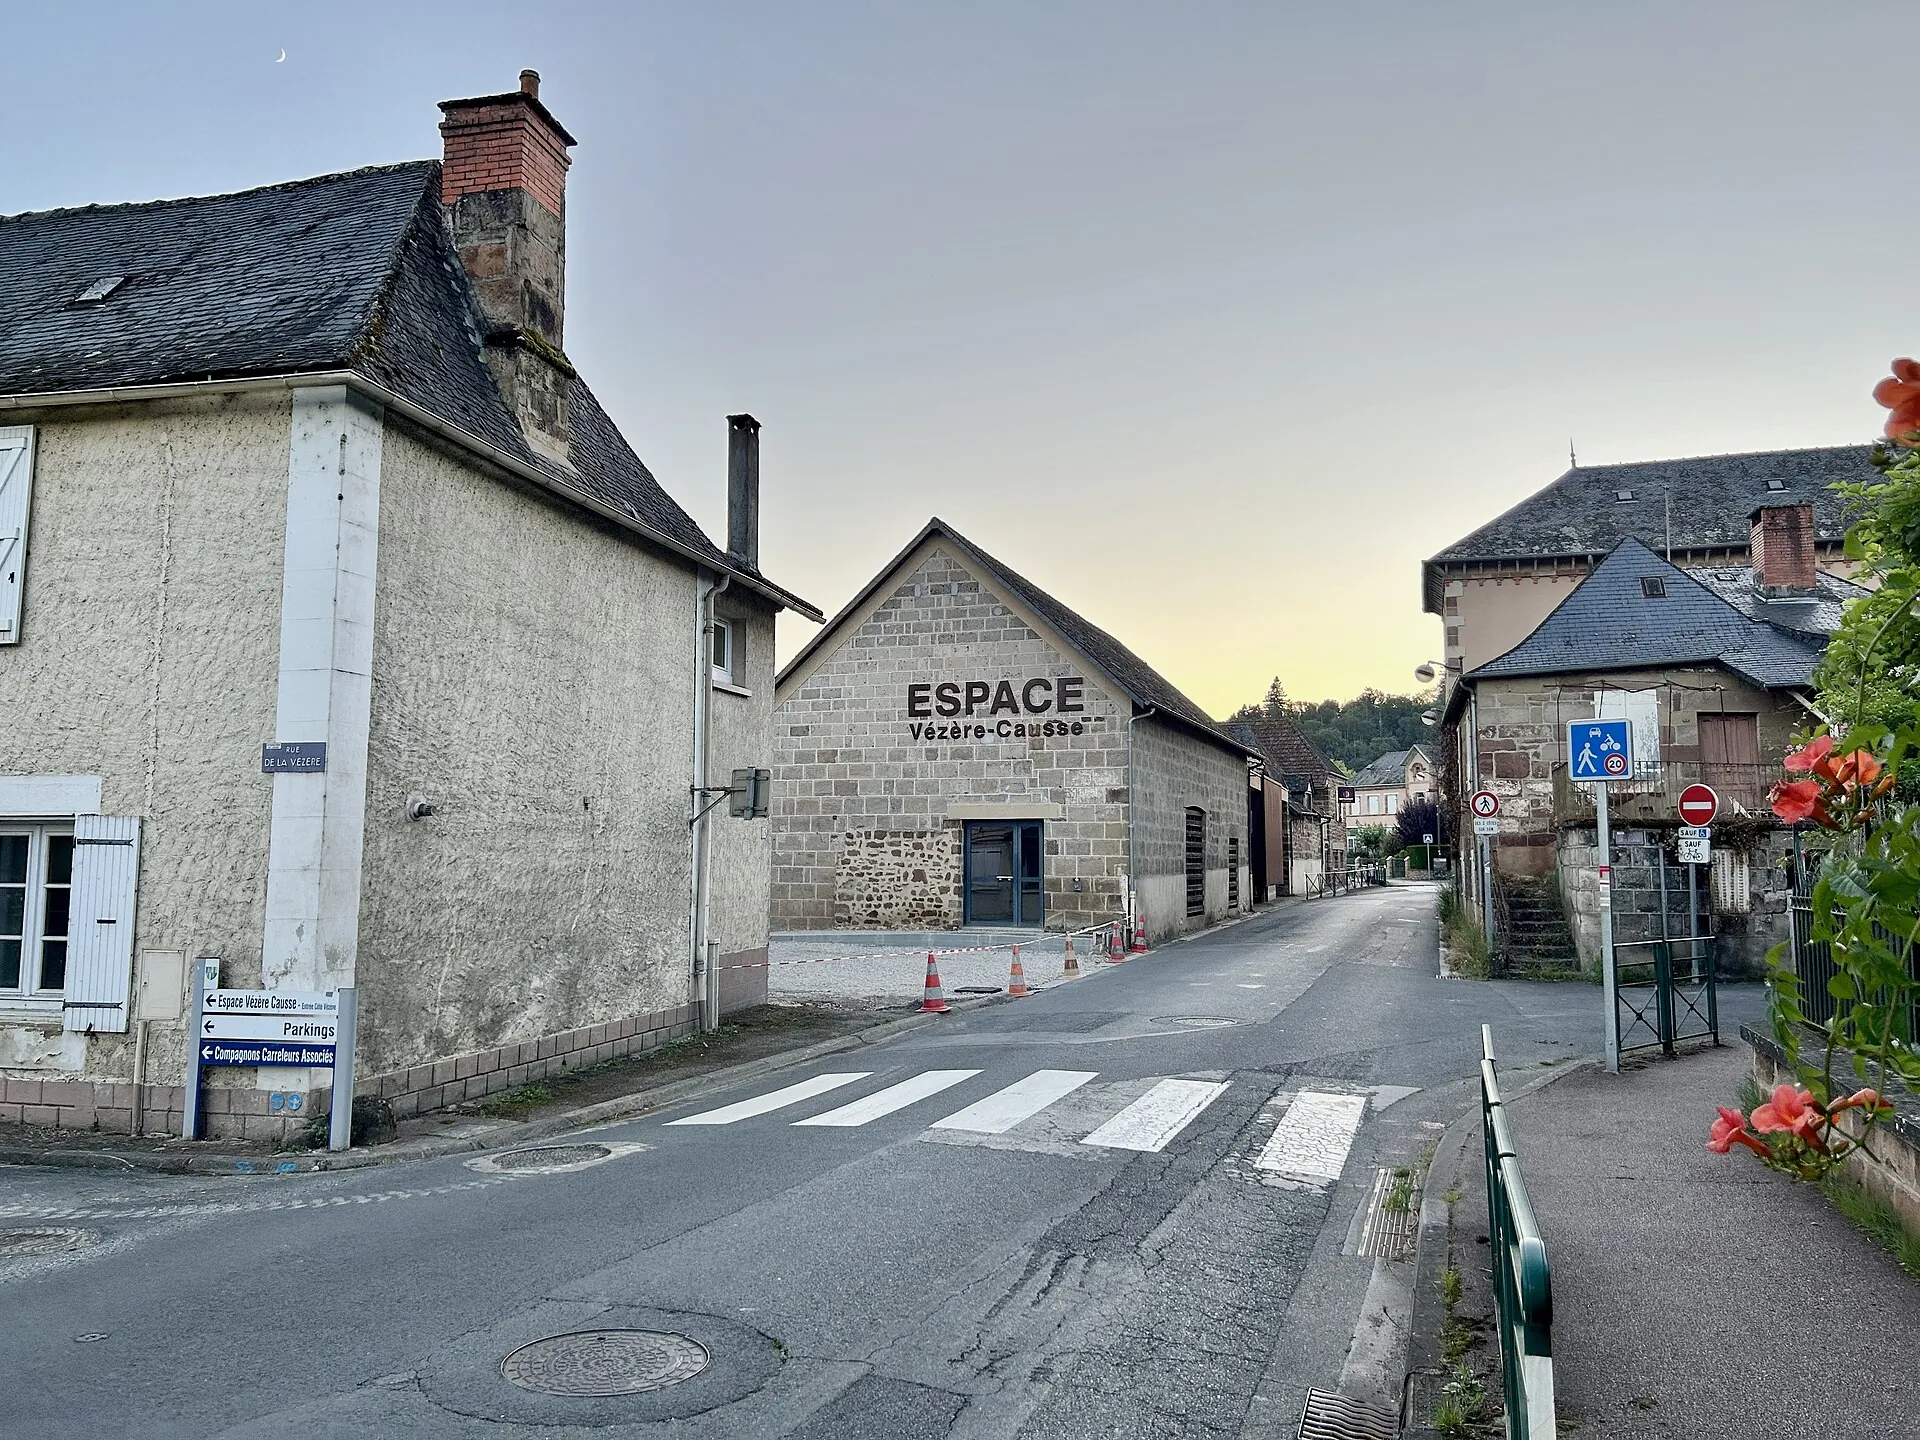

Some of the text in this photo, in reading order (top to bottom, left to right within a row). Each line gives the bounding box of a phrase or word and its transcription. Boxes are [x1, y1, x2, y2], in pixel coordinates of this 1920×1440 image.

[908, 677, 1084, 718] ESPACE
[909, 719, 1084, 741] Vézère-Causse
[264, 758, 275, 767] DE
[276, 758, 288, 767] LA
[1609, 759, 1622, 769] 20
[1684, 840, 1702, 848] SAUF
[218, 994, 243, 1010] Espace
[245, 994, 269, 1009] Vézère
[271, 995, 297, 1010] Causse
[283, 1022, 335, 1040] Parkings
[214, 1045, 334, 1064] Compagnons Carreleurs Associés
